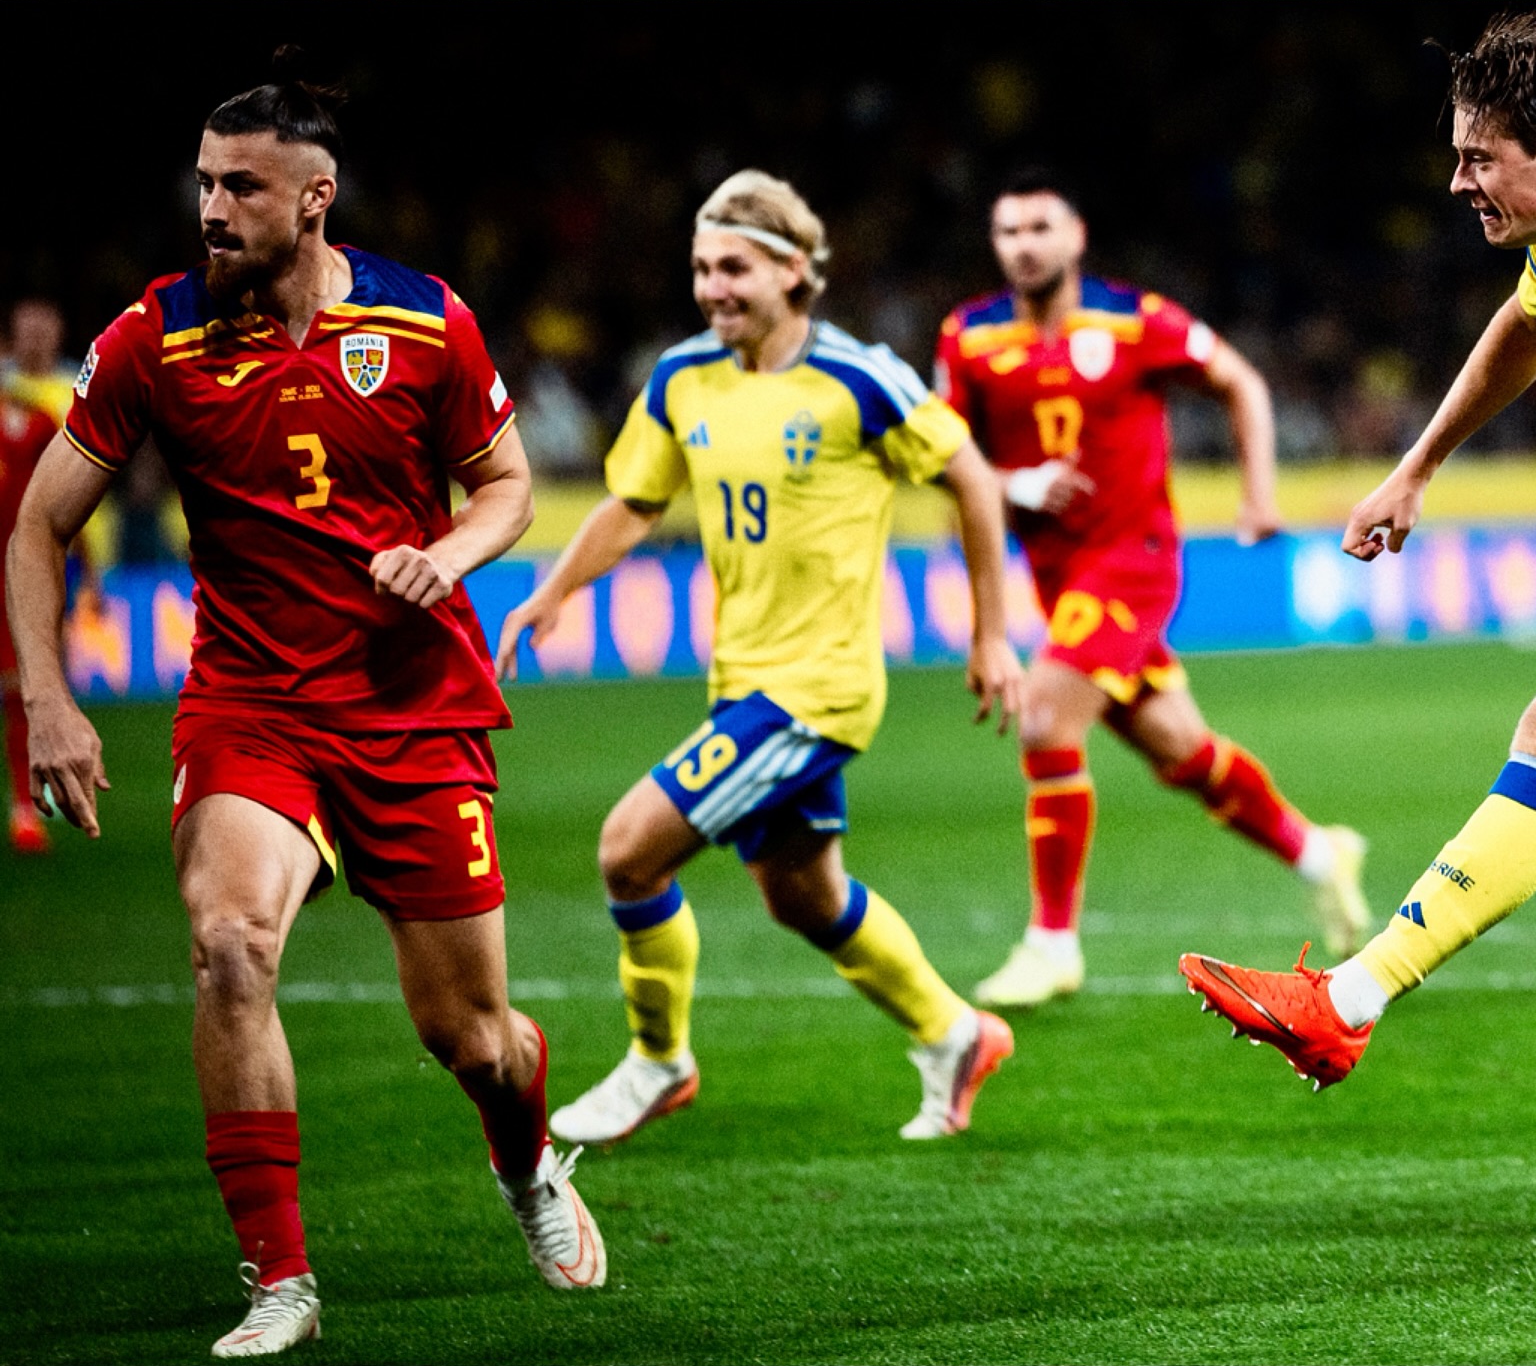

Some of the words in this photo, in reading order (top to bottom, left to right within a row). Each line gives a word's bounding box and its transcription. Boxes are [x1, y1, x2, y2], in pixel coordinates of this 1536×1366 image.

[287, 433, 331, 510] 3
[718, 481, 768, 543] 19
[663, 720, 738, 792] 19
[458, 801, 492, 878] 3
